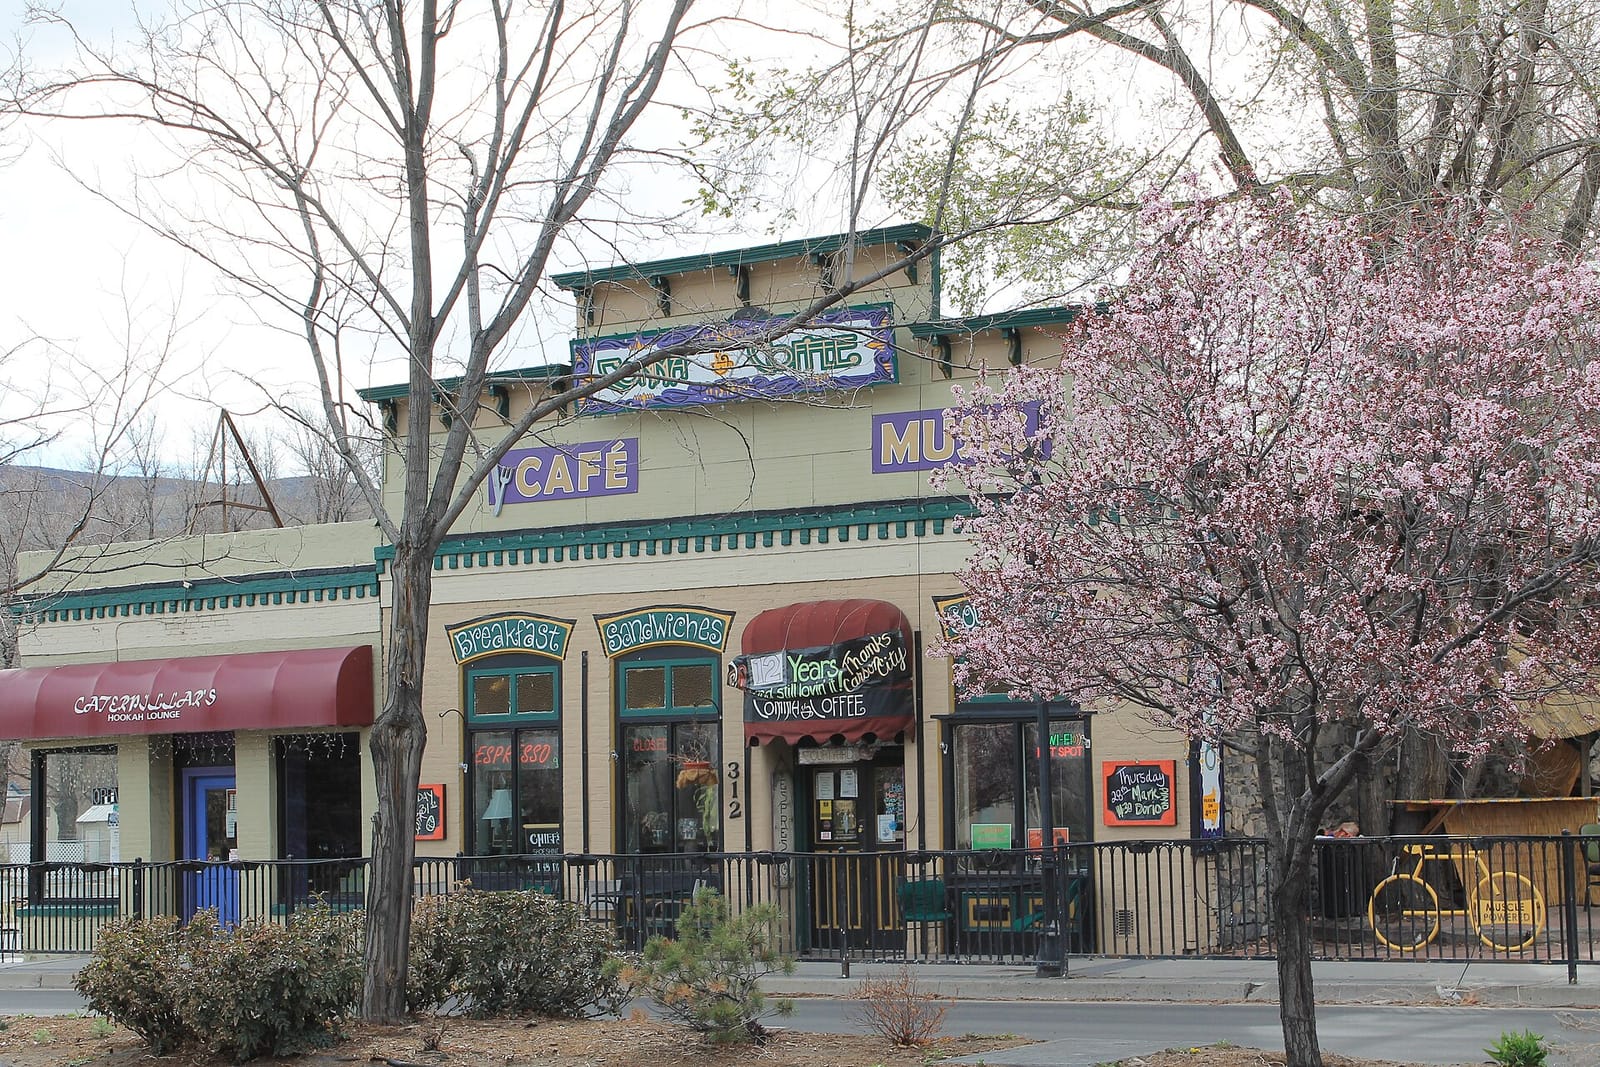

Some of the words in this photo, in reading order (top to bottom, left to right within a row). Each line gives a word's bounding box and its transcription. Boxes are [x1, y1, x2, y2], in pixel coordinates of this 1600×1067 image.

[516, 440, 628, 497] CAFÉ
[454, 620, 560, 658] Breakfast
[607, 614, 722, 652] Sandwiches
[841, 632, 892, 675] Thanks
[752, 655, 782, 684] 12
[787, 655, 838, 682] Years
[843, 659, 879, 692] Carson
[876, 647, 906, 676] City
[74, 688, 217, 714] CATERPILLAR'S
[776, 684, 797, 699] still
[107, 713, 144, 721] HOOKAH
[146, 710, 180, 719] LOUNGE
[475, 744, 551, 763] ESPRSSO
[1058, 746, 1083, 758] SPOT
[1116, 767, 1165, 787] Thursday
[779, 777, 789, 877] ESPRESO
[1483, 913, 1530, 921] POWERD
